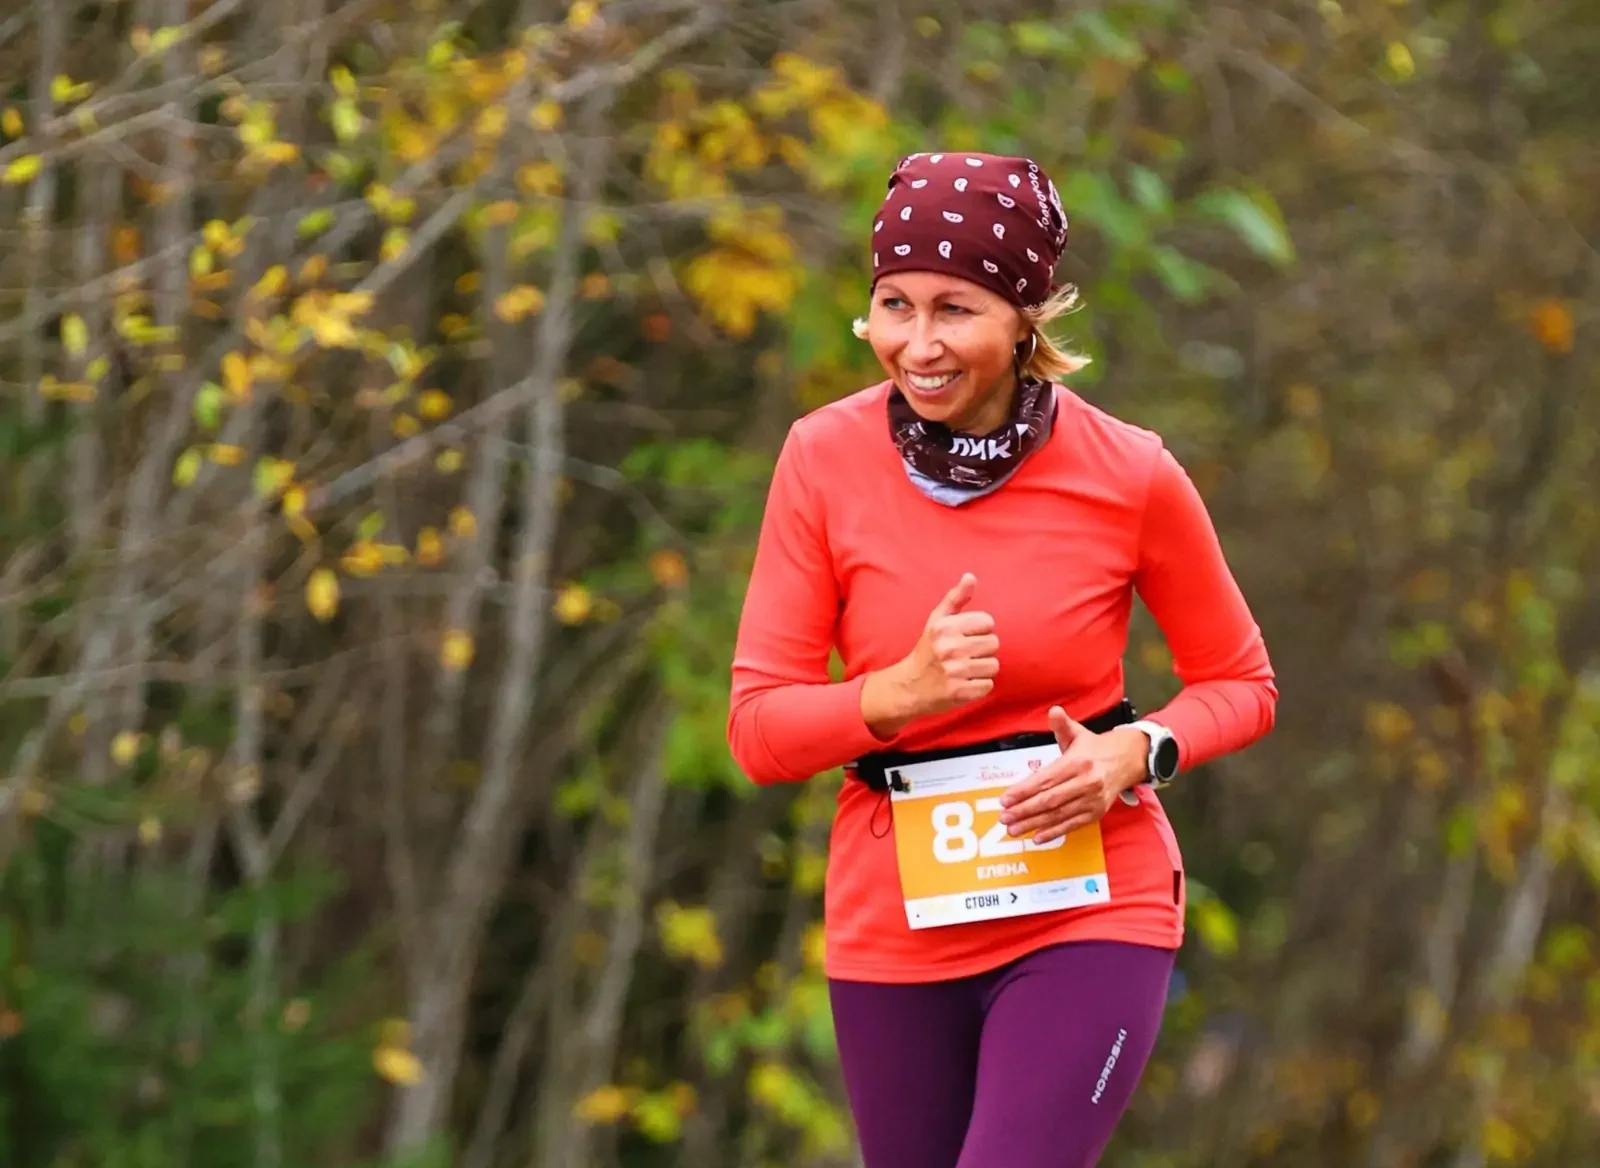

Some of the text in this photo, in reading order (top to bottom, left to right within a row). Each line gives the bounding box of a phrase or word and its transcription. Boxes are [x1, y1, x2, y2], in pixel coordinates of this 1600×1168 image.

[976, 861, 1029, 881] ЕЛЕНА
[965, 893, 1000, 910] СТОУН
[1091, 1028, 1128, 1105] NORDSKI
